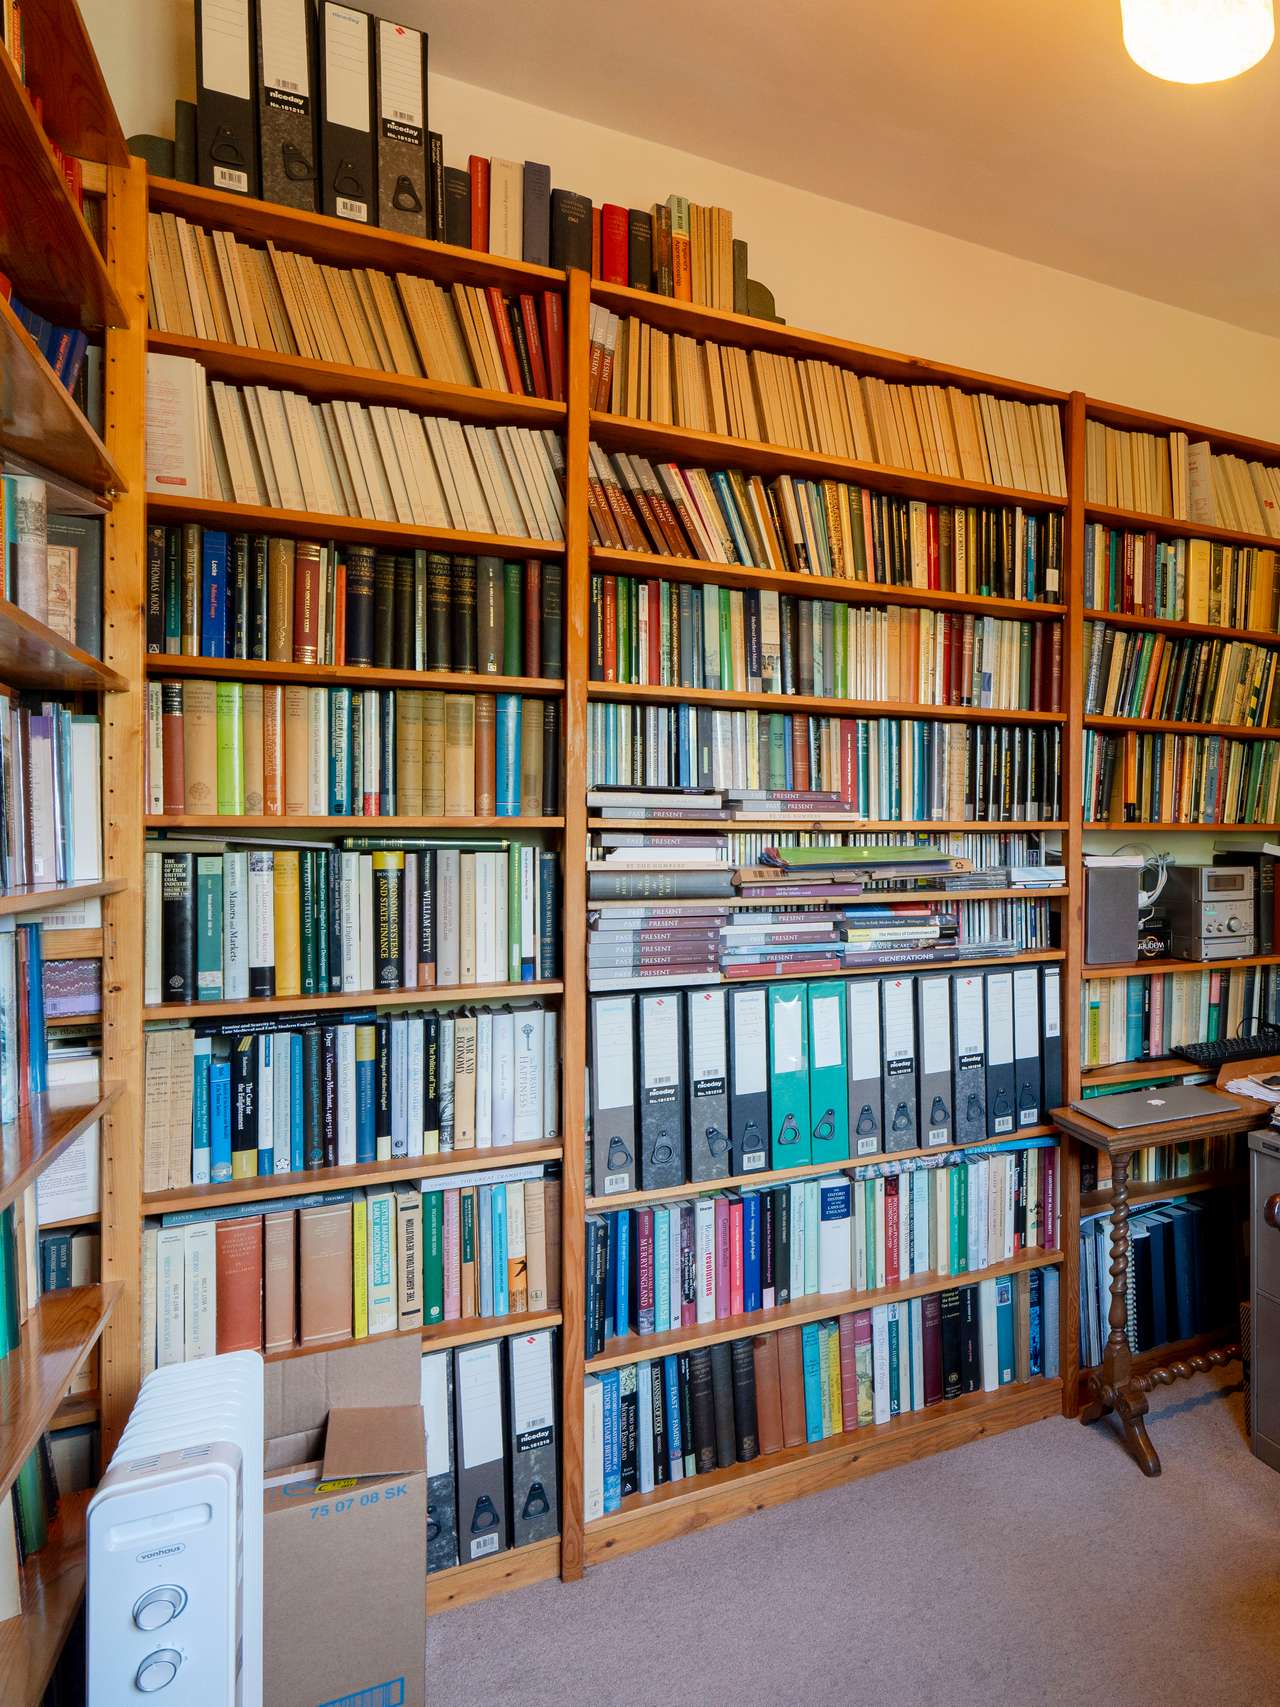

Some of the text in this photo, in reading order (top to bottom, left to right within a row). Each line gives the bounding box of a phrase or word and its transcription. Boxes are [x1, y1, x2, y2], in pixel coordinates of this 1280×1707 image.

[270, 91, 304, 105] niceday
[387, 122, 418, 136] niceday
[150, 560, 160, 616] THOMAS MORE
[772, 792, 800, 800] PRESENT
[652, 838, 681, 846] PRESENT
[344, 879, 353, 911] Foreigners
[229, 890, 239, 962] Manors Markets
[344, 912, 353, 924] and
[380, 878, 389, 959] AND STATE FINANCE
[390, 878, 398, 960] ECONOMIC SYSTEMS
[422, 890, 431, 953] WILLIAM PETTY
[344, 925, 354, 961] Englishmen
[640, 932, 672, 940] PRESENT
[772, 934, 798, 942] PRESENT
[640, 944, 672, 953] PRESENT
[878, 953, 935, 962] GENERATIONS
[640, 956, 671, 965] PRESENT
[640, 968, 671, 976] PRESENT
[325, 1033, 334, 1046] Dyer
[428, 1044, 436, 1054] The
[456, 1036, 464, 1074] ECONOMY
[465, 1036, 474, 1074] WAR AND
[890, 1060, 911, 1068] niceday
[961, 1055, 981, 1063] niceday
[324, 1058, 334, 1080] Country
[428, 1056, 436, 1075] Politics
[428, 1084, 436, 1099] Trade
[519, 1056, 529, 1108] HAPPINESS
[697, 1080, 722, 1089] niceday
[326, 1081, 334, 1110] Merchant,
[649, 1088, 675, 1097] niceday
[237, 1092, 246, 1130] Enlightenment
[374, 1252, 382, 1283] ENGLAND
[406, 1218, 414, 1302] THE AGRICULTURAL REVOLUTION
[640, 1238, 648, 1306] MERRY ENGLAND
[658, 1224, 668, 1320] POLITICS DISCOURSE
[604, 1384, 612, 1409] TUDOR
[521, 1431, 550, 1442] niceday
[604, 1417, 612, 1440] STUART
[672, 1419, 680, 1448] FAMINE
[311, 1485, 408, 1519] 75 07 08 SK
[141, 1546, 182, 1560] vonhaus
